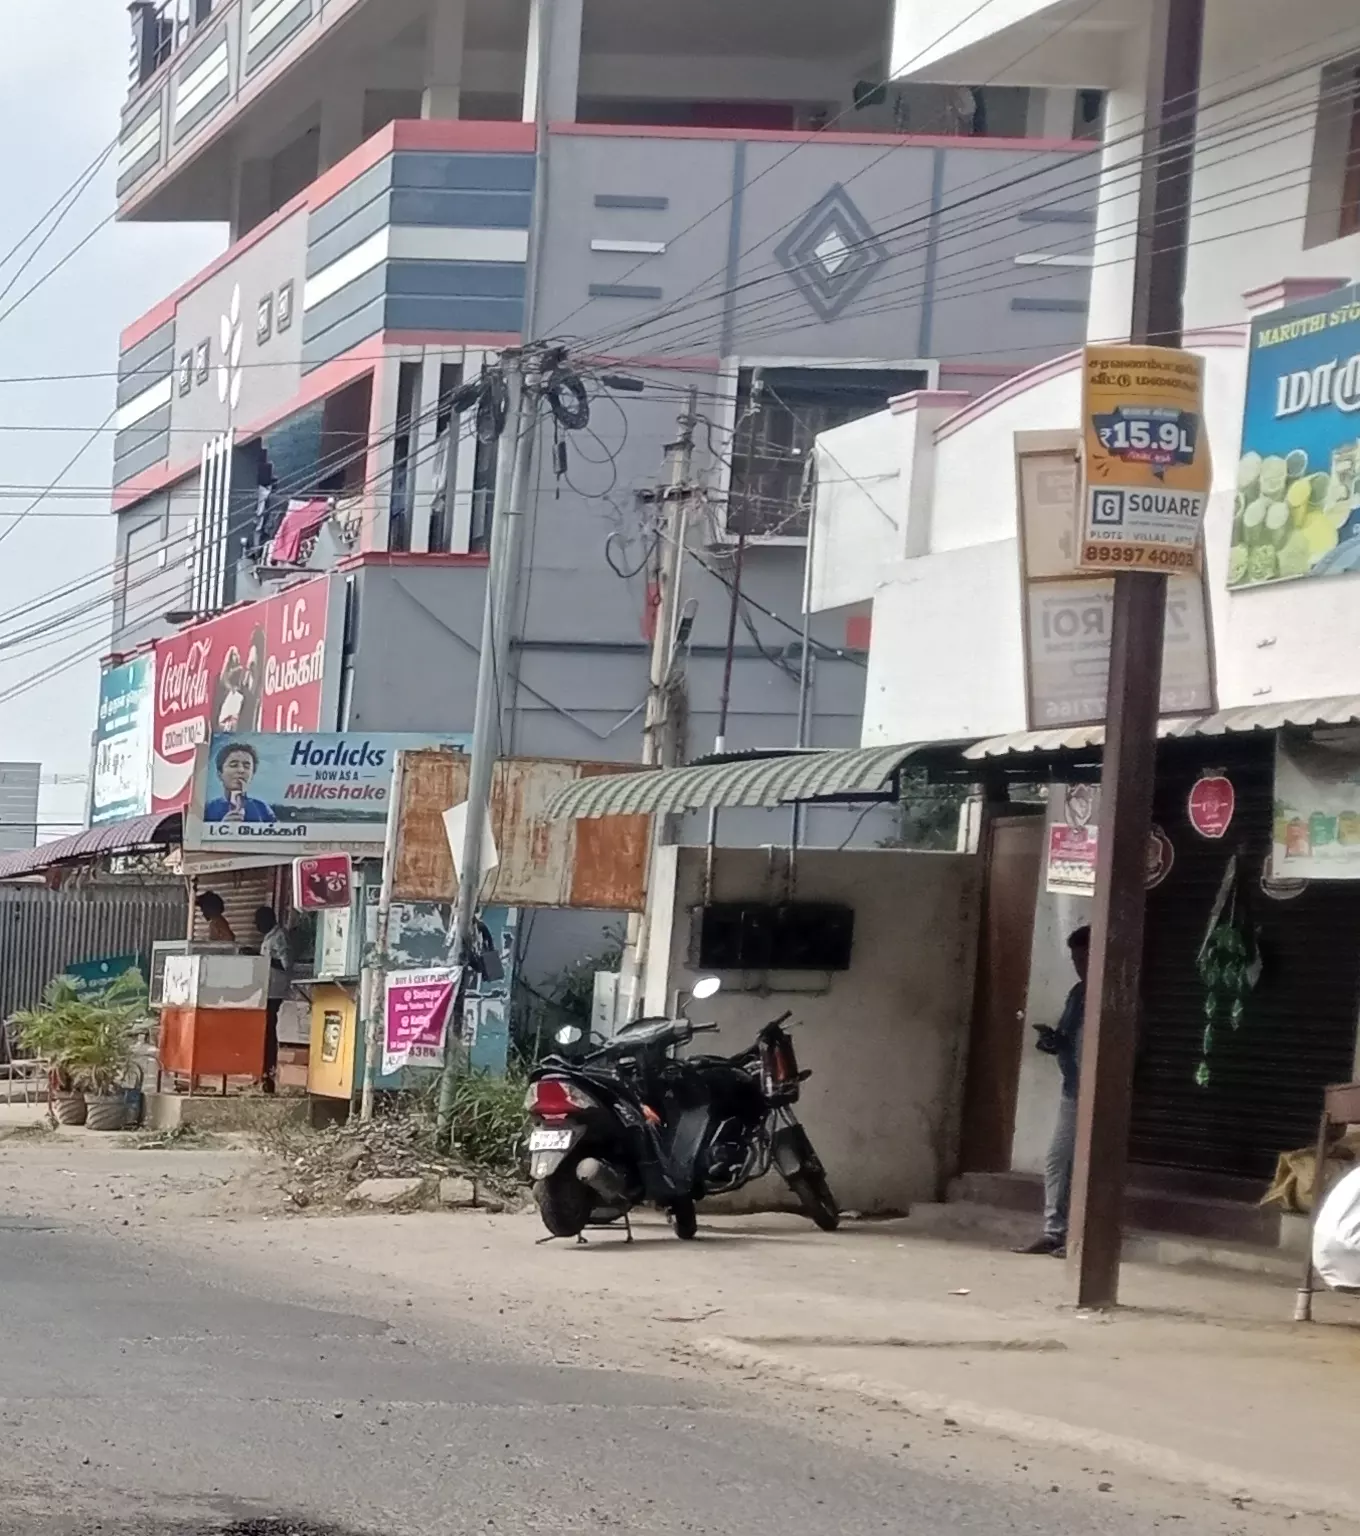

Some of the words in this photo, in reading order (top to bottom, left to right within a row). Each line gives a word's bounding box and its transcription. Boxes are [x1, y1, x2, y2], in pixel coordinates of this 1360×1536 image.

[1257, 312, 1327, 348] MARUTHI
[1102, 498, 1116, 517] G
[1128, 493, 1201, 517] SQUARE
[1090, 531, 1123, 540] PLOTS
[1086, 545, 1145, 562] 89397
[281, 597, 311, 645] I.C.
[264, 639, 326, 697] பேக்கரி
[290, 740, 387, 768] Horlicks
[315, 770, 337, 781] NOW
[338, 770, 351, 781] AS
[352, 770, 359, 780] A
[284, 783, 386, 801] Milkshake
[209, 824, 233, 836] I.C.
[237, 823, 308, 837] பேக்கரி
